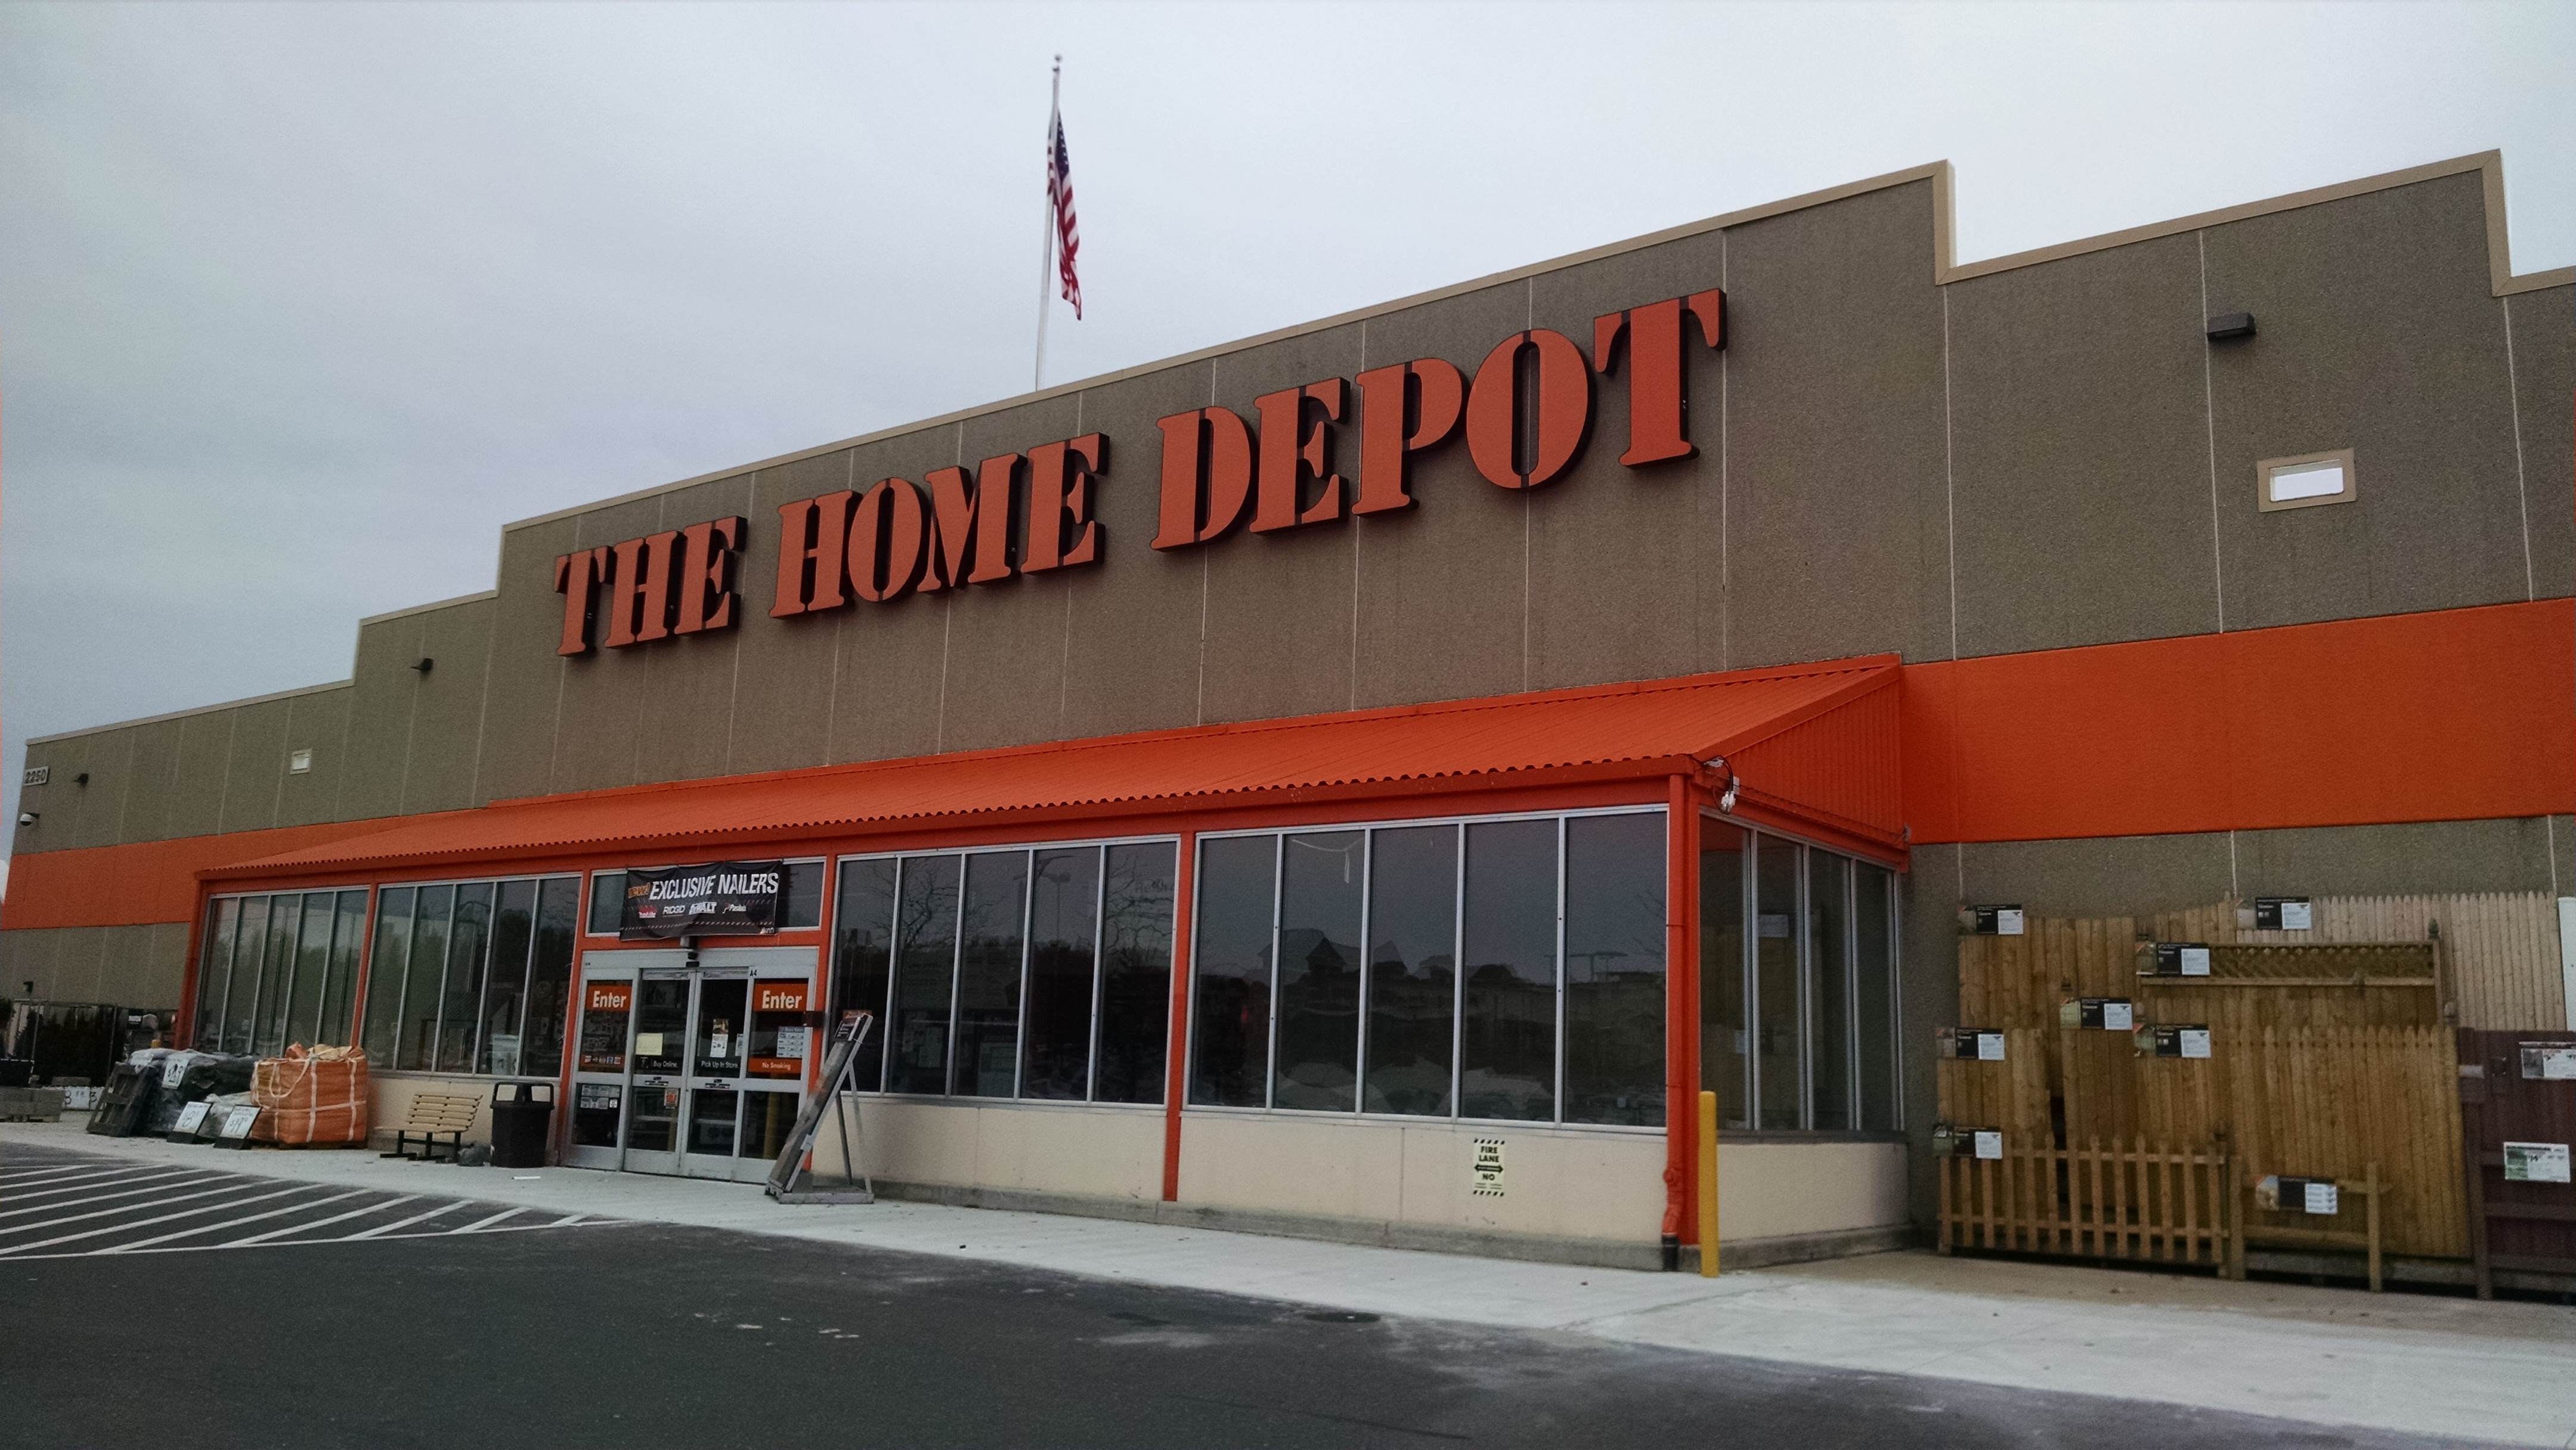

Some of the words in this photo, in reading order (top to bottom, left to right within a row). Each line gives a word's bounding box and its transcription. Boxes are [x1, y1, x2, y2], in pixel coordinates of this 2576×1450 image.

[555, 516, 747, 656] THE
[770, 432, 1109, 619] HOME
[1150, 288, 1727, 552] DEPOT
[26, 769, 47, 783] 2250
[649, 875, 716, 900] EXCLUSIVE
[718, 872, 779, 894] NAILERS
[593, 990, 627, 1008] Enter
[762, 990, 803, 1009] Enter
